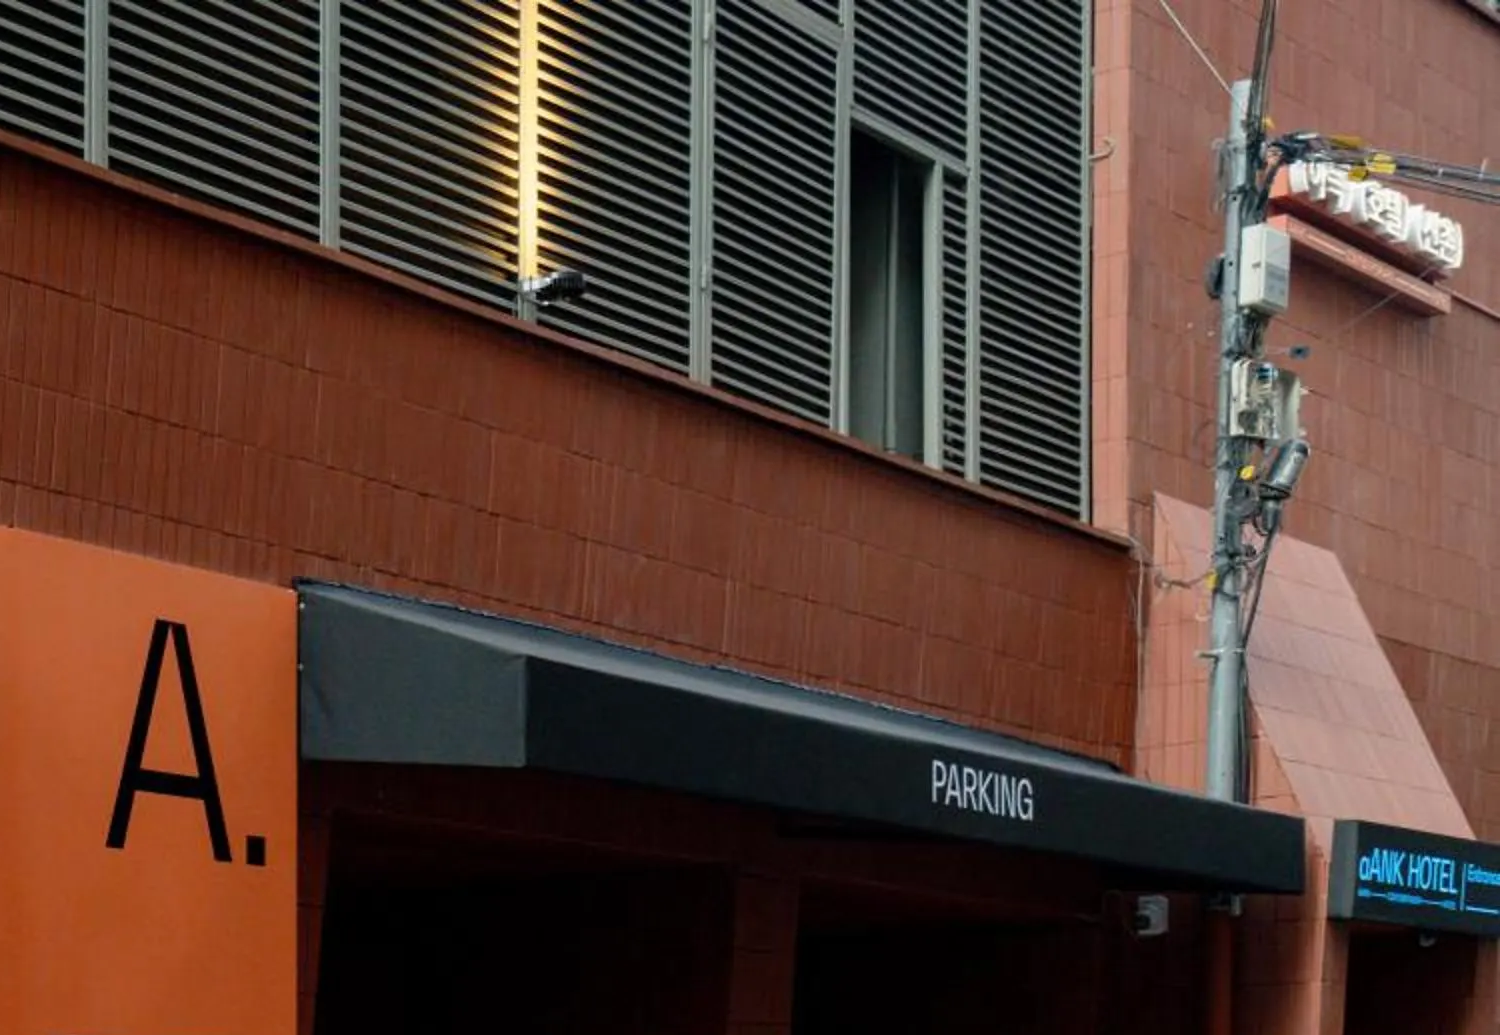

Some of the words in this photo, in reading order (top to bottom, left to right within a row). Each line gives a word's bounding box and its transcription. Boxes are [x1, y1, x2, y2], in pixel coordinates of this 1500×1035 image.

[105, 618, 266, 867] A.
[931, 759, 1034, 822] PARKING
[1407, 853, 1458, 894] HOTEL
